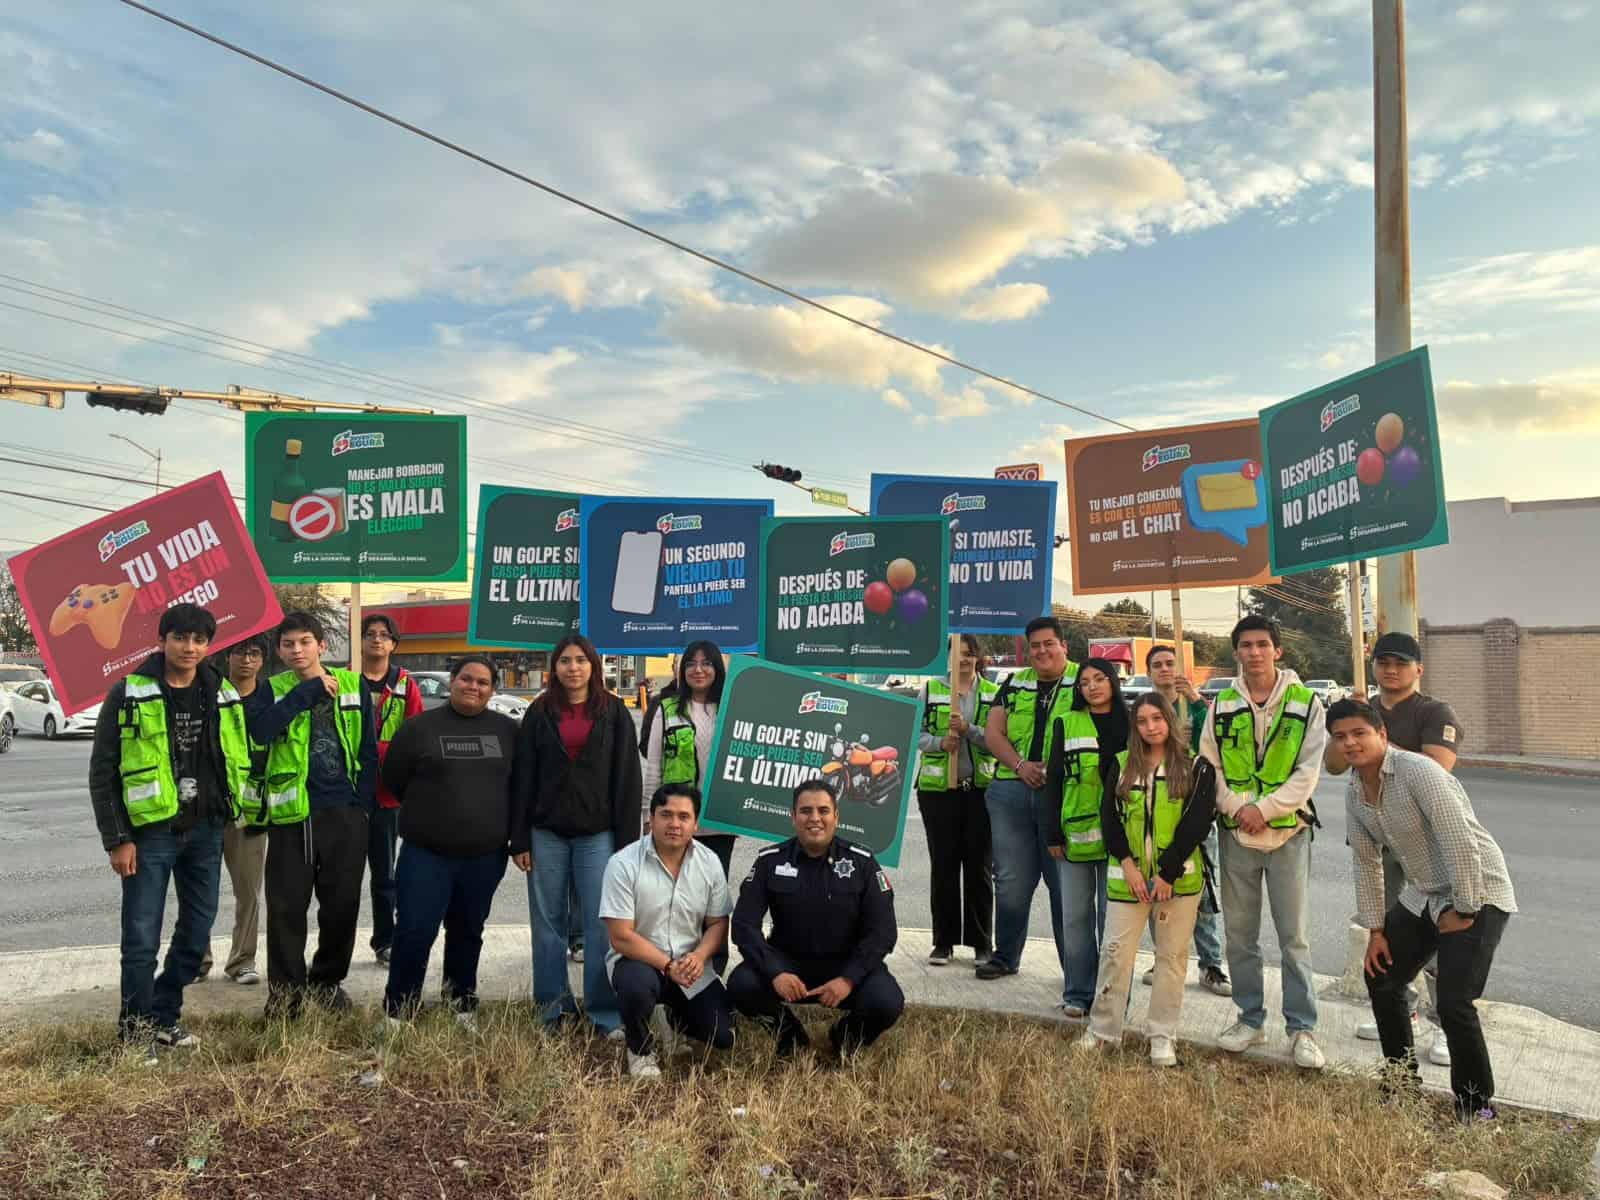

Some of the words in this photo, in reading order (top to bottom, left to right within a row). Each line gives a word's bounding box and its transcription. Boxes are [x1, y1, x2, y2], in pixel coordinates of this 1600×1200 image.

[348, 467, 393, 481] MANEJAR
[396, 463, 444, 478] BORRACHO
[1281, 446, 1335, 489] DESPUÉS
[1338, 439, 1356, 464] DE
[348, 494, 373, 521] ES
[381, 487, 445, 519] MALA
[1088, 499, 1101, 512] TU
[1102, 495, 1135, 511] MEJOR
[1137, 485, 1182, 504] CONEXIÓN
[1282, 501, 1302, 528] NO
[1308, 475, 1360, 520] ACABA
[955, 532, 968, 550] SI
[971, 528, 1036, 549] TOMASTE,
[1089, 532, 1100, 543] NO
[1102, 530, 1118, 541] CON
[1122, 521, 1139, 539] EL
[1144, 512, 1182, 535] CHAT
[120, 551, 158, 588] TU
[157, 520, 221, 569] VIDA
[493, 546, 513, 564] UN
[516, 546, 561, 564] GOLPE
[564, 547, 580, 564] SI
[665, 548, 683, 564] UN
[686, 542, 745, 563] SEGUNDO
[167, 563, 197, 596] ES
[665, 563, 721, 584] VIENDO
[727, 559, 745, 578] TU
[779, 568, 841, 595] DESPUÉS
[846, 569, 865, 589] DE
[950, 562, 970, 583] NO
[975, 561, 993, 582] TU
[998, 560, 1033, 582] VIDA
[167, 579, 219, 609] EGO
[489, 579, 510, 602] EL
[664, 583, 703, 597] PANTALLA
[705, 580, 729, 592] PUEDE
[730, 579, 745, 590] SER
[777, 607, 801, 630] NO
[806, 601, 865, 629] ACABA
[447, 743, 479, 752] PUMA
[733, 719, 754, 741] UN
[756, 721, 801, 748] GOLPE
[804, 728, 828, 753] SIN
[729, 740, 765, 758] CASCO
[767, 746, 801, 764] PUEDE
[803, 752, 823, 767] SER
[723, 755, 744, 783] EL
